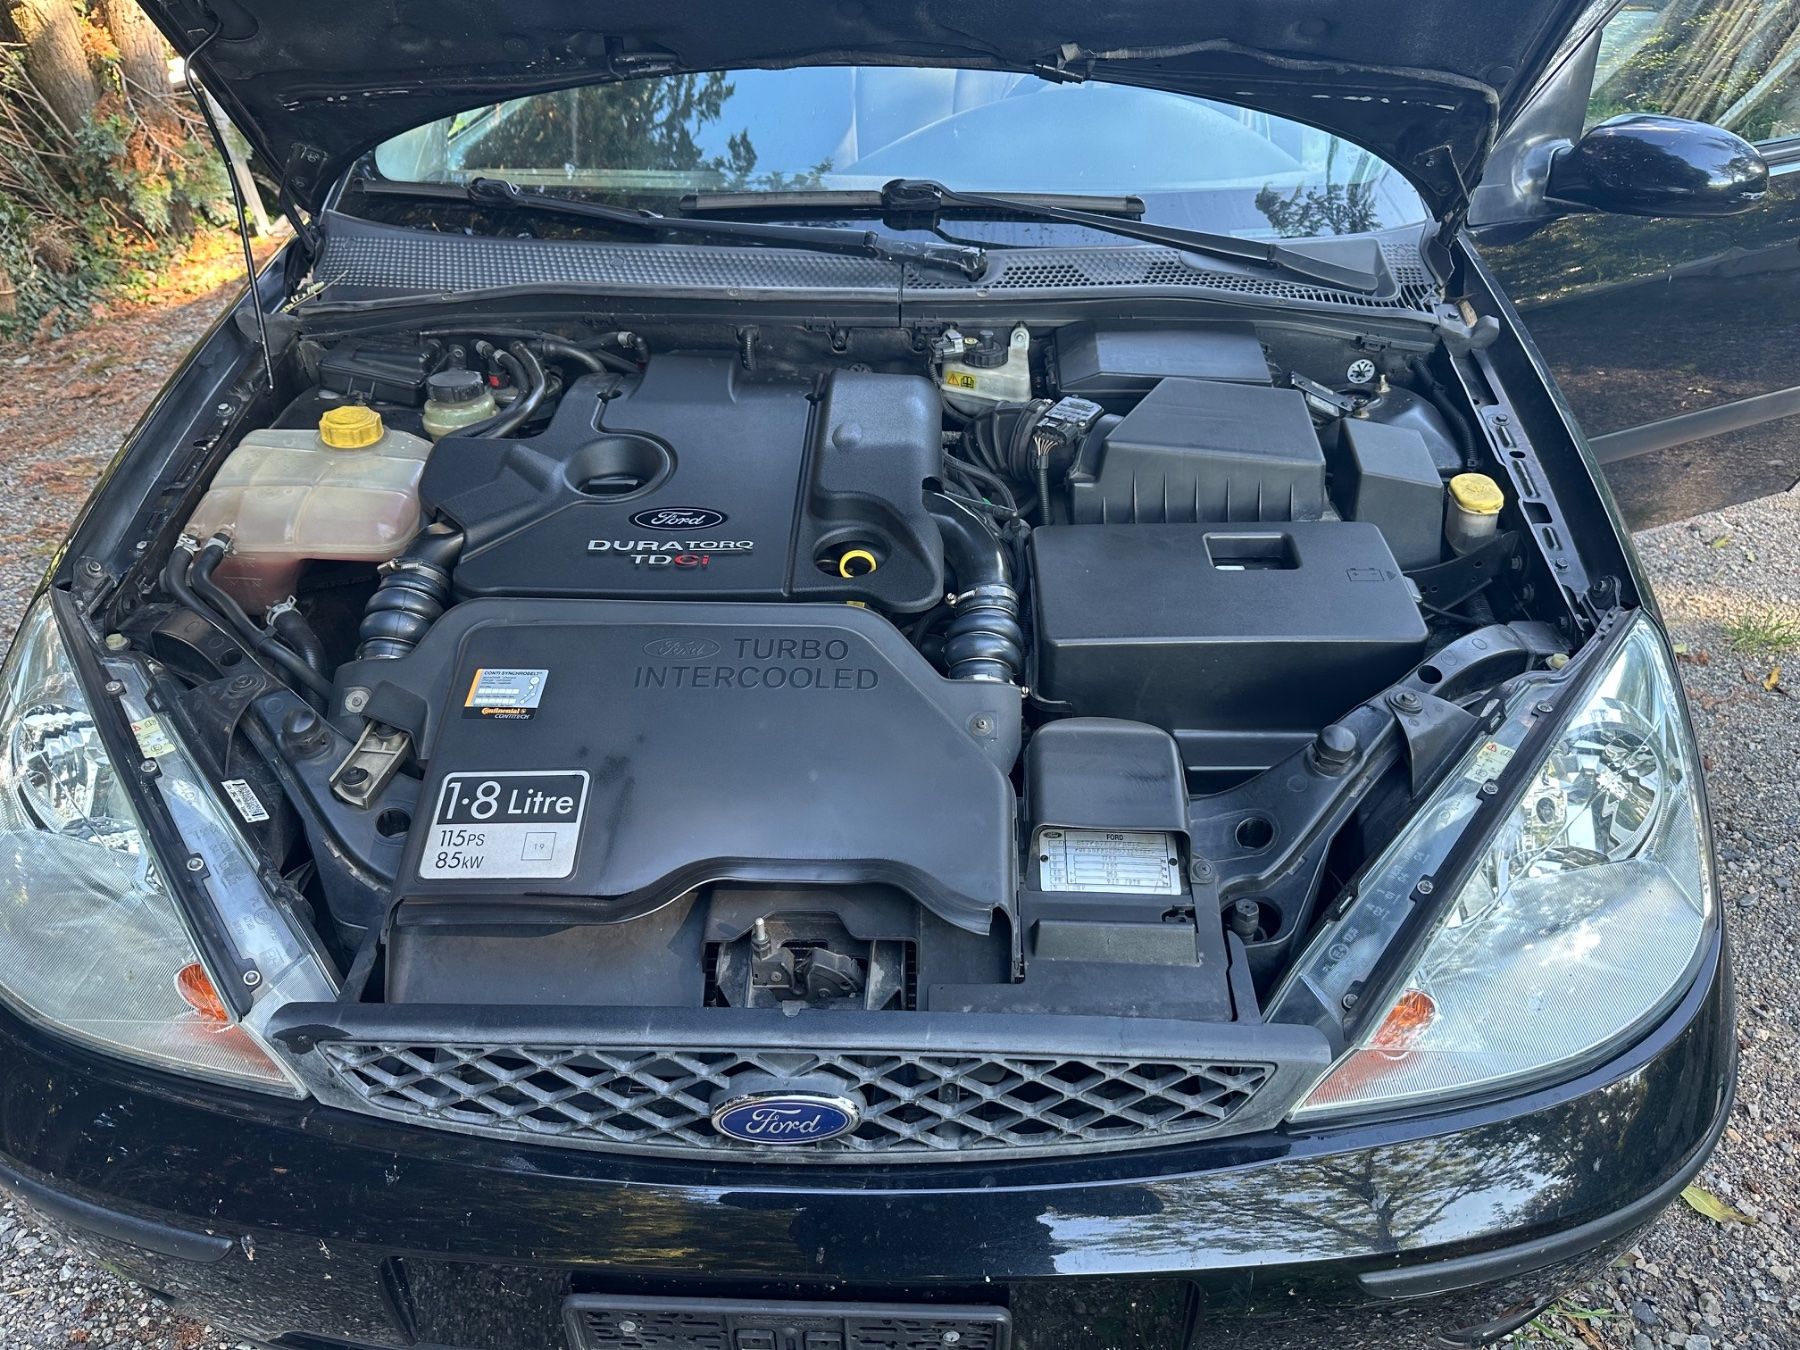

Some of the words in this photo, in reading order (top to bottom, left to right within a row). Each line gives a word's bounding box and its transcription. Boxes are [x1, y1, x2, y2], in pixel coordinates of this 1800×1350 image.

[651, 510, 706, 525] Ford
[587, 540, 754, 551] DURATORQ
[630, 554, 710, 567] TDCi
[657, 640, 704, 656] Ford
[734, 638, 849, 661] TURBO
[633, 666, 880, 690] INTERCOOLED
[481, 707, 521, 715] Continental
[507, 788, 574, 815] Litre
[745, 1108, 822, 1134] Ford
